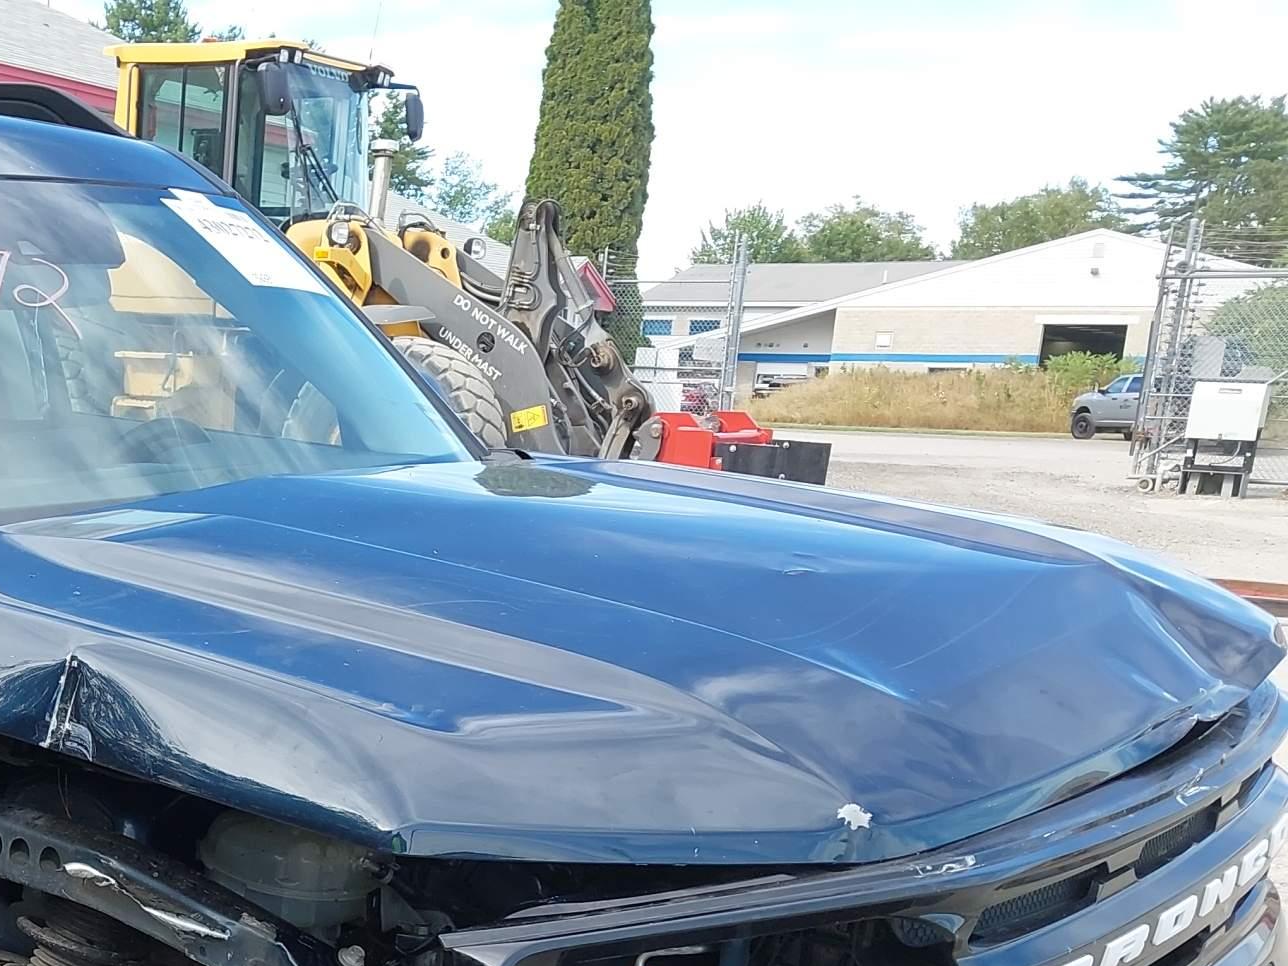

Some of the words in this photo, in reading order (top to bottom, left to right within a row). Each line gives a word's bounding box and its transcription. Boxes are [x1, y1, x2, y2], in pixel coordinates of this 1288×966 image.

[439, 326, 473, 360] UNDER
[471, 353, 503, 381] MAST
[453, 294, 471, 311] DO
[471, 307, 497, 330] NOT
[496, 324, 529, 355] WALK
